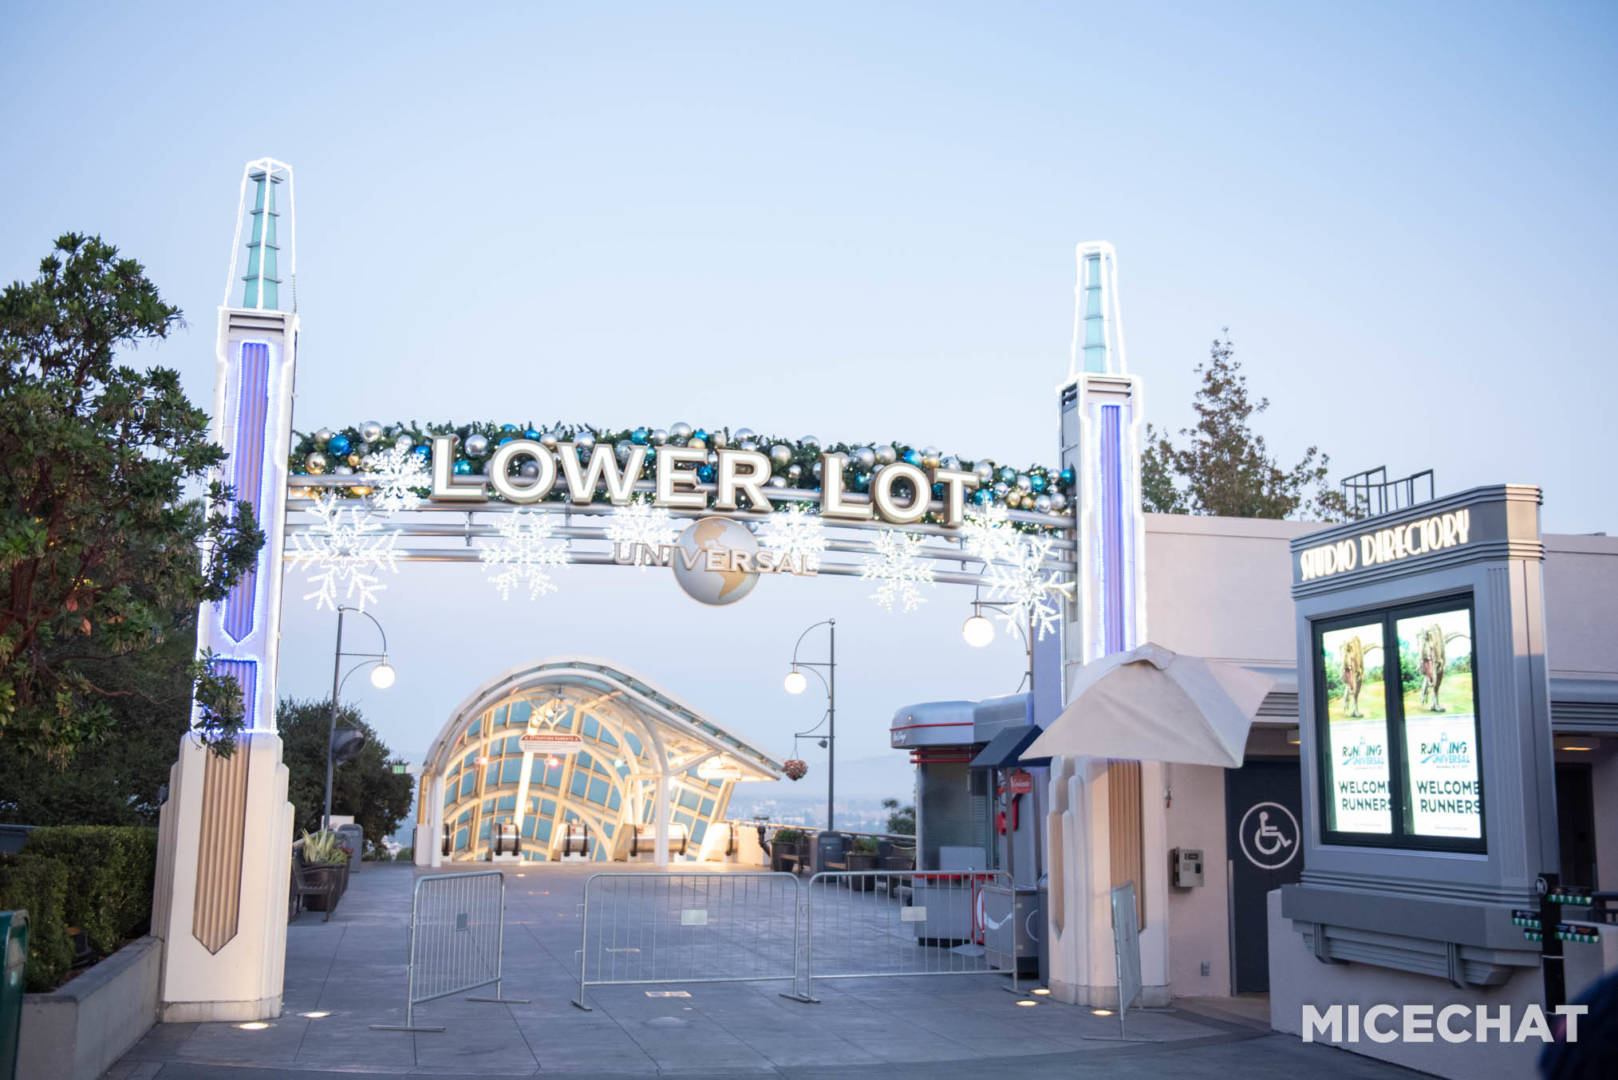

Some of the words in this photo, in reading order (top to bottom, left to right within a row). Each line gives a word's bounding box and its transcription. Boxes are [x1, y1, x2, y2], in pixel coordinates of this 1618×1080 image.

[429, 435, 774, 513] LOWER
[820, 453, 980, 528] LOT
[1300, 539, 1357, 582] STUDIO
[1360, 509, 1470, 567] DIRECTORY
[613, 541, 819, 577] UNIVERSAL
[1420, 741, 1468, 754] RUNING
[1416, 780, 1480, 795] WELCOME
[1420, 798, 1481, 815] RUNNERS
